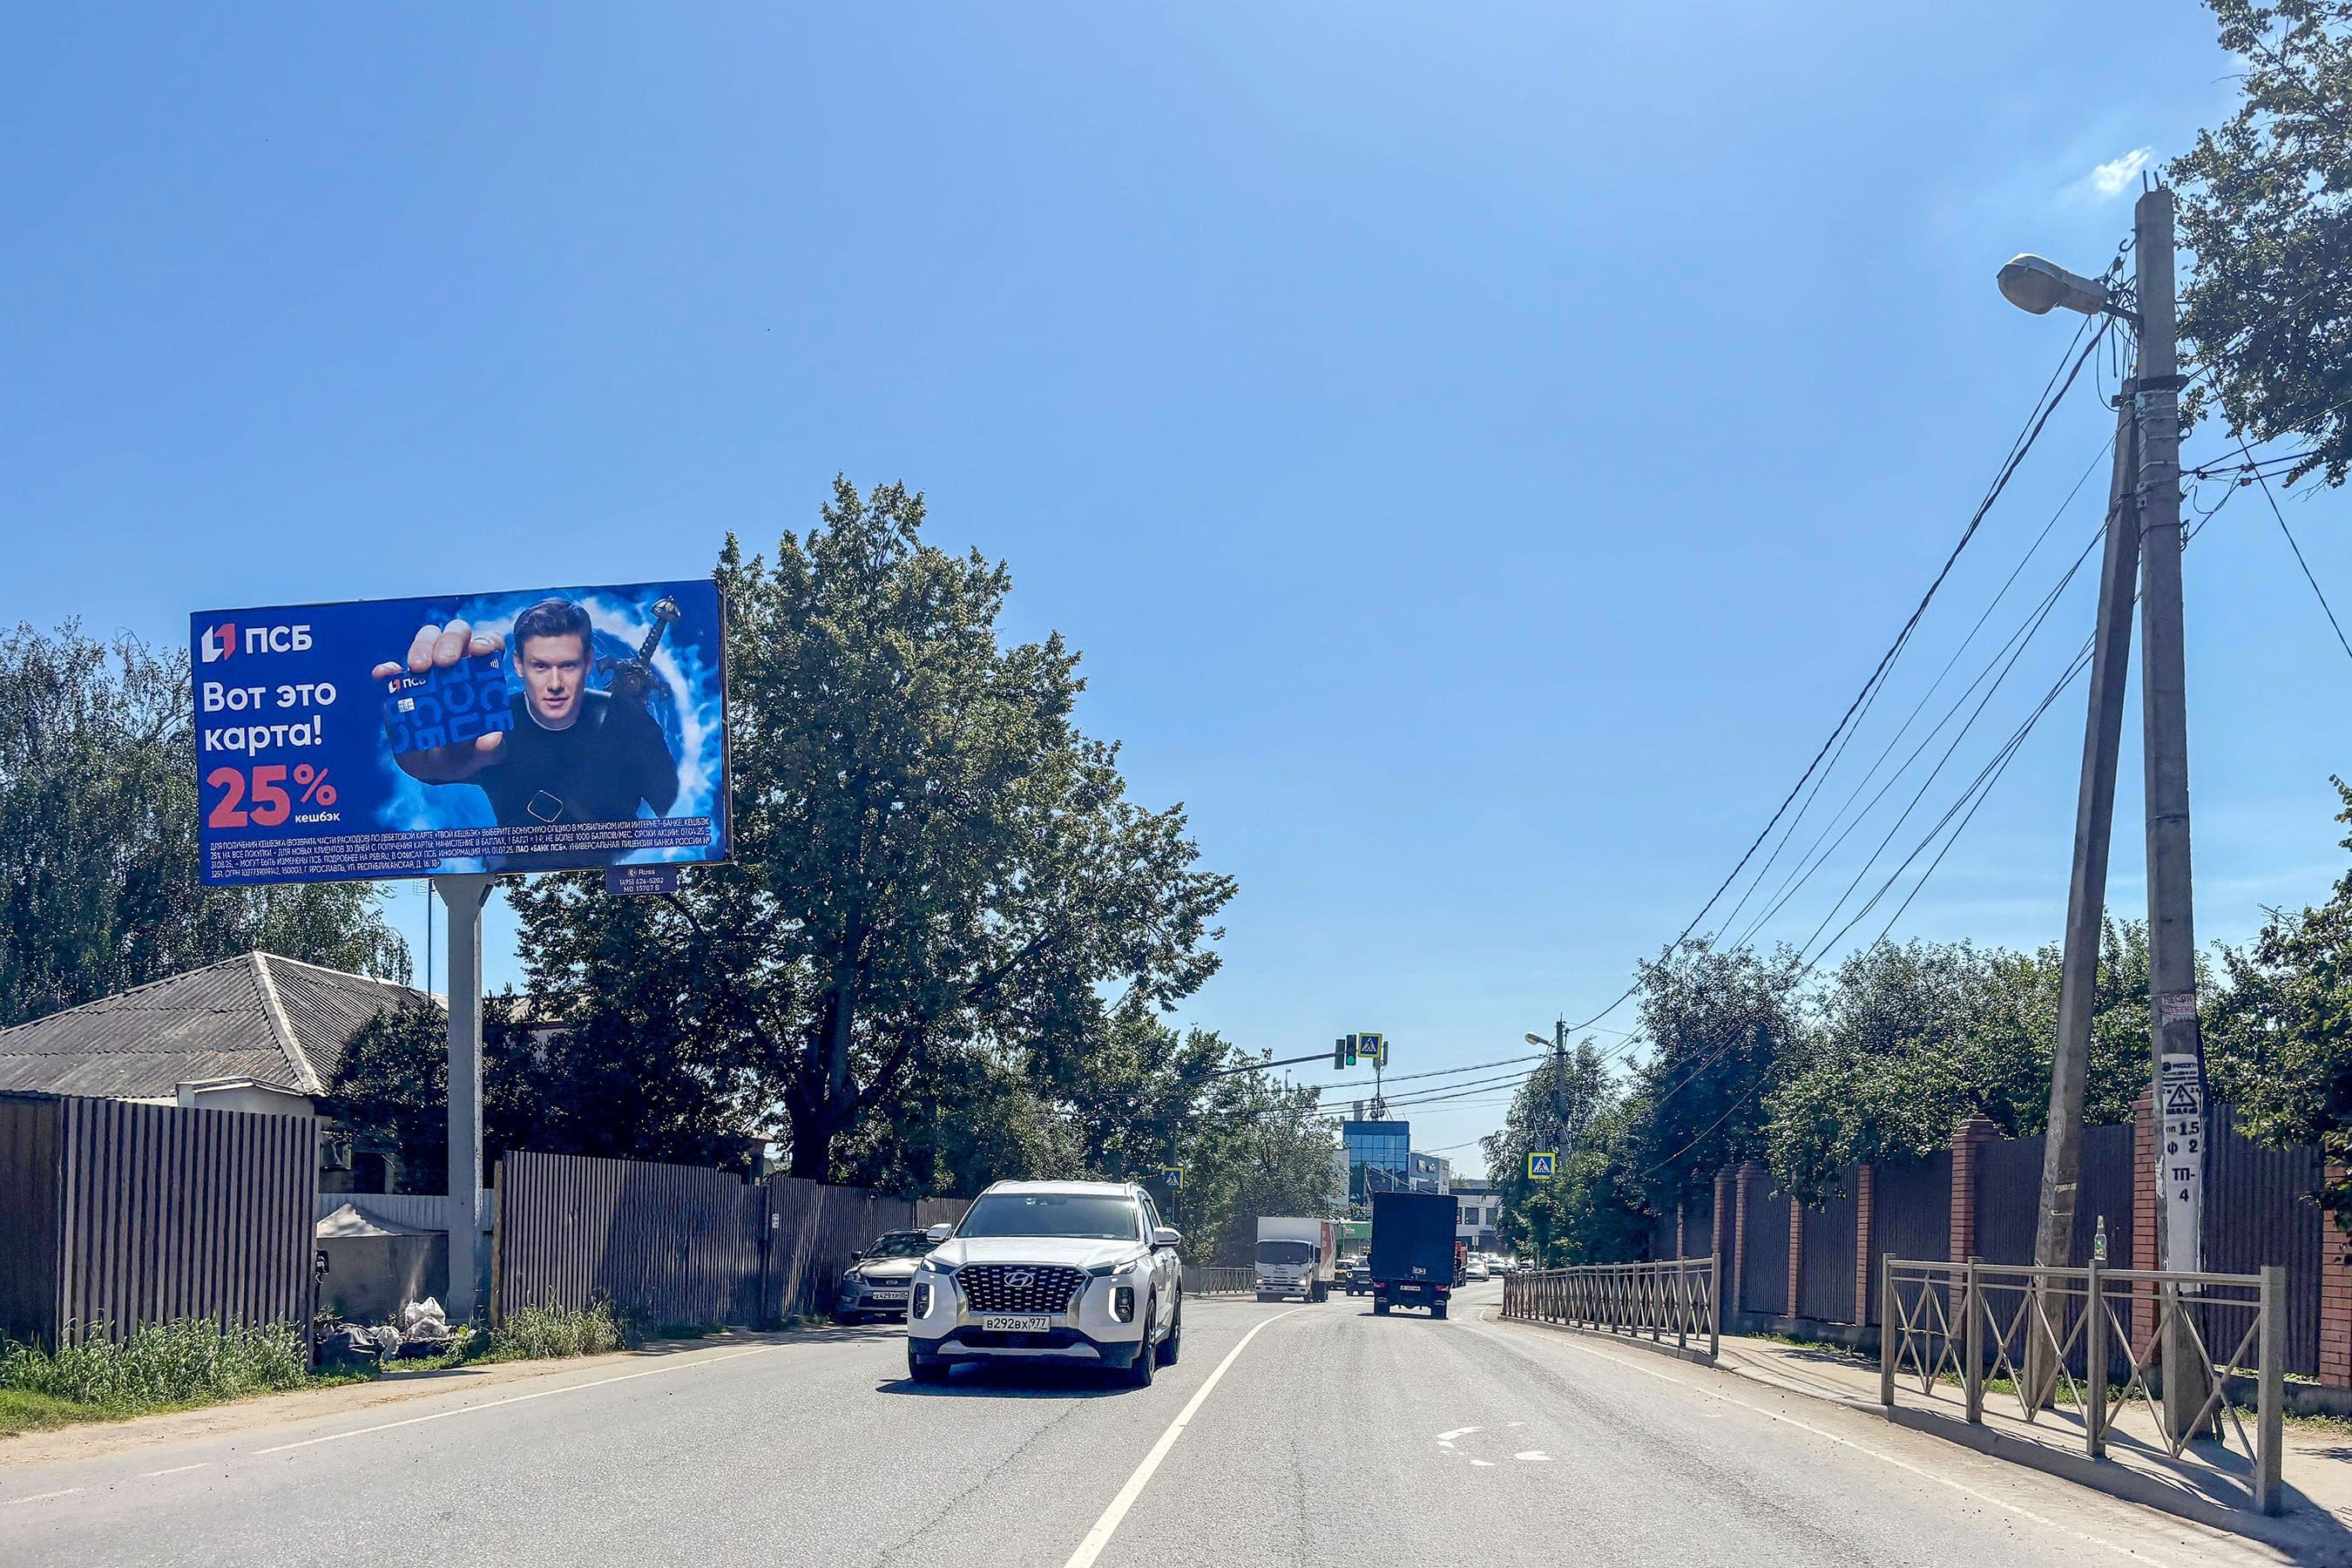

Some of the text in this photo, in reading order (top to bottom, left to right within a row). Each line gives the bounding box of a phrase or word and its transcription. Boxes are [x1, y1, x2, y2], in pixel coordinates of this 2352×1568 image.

[246, 625, 313, 654] ПСБ
[203, 681, 337, 713] Вот это
[205, 714, 322, 757] карта!
[206, 763, 337, 828] 25%
[294, 811, 341, 823] кешбэк
[371, 834, 380, 843] ПО
[381, 832, 415, 842] ДЕБЕТОВОЙ
[415, 831, 433, 841] КАРТЕ
[481, 827, 511, 837] ВЫБЕРИТЕ
[547, 825, 571, 834] ОПЦИЮ
[571, 824, 577, 833] В
[577, 822, 617, 833] МОБИЛЬНОМ
[684, 818, 710, 827] КЕШБЭК
[222, 851, 231, 859] НА
[232, 850, 243, 859] ВСЕ
[244, 849, 272, 858] ПОКУПКИ
[278, 848, 291, 857] ДЛЯ
[291, 847, 312, 856] НОВЫХ
[371, 844, 377, 852] С
[378, 842, 412, 852] ПОЛУЧЕНИЯ
[435, 839, 474, 849] НАЧИСЛЕНИЕ
[475, 838, 480, 847] В
[512, 836, 528, 845] БАЛЛ
[545, 835, 554, 843] НЕ
[554, 834, 574, 843] БОЛЕЕ
[634, 830, 656, 839] СРОКИ
[359, 853, 368, 862] НА
[392, 852, 396, 860] В
[438, 848, 481, 858] ИНФОРМАЦИЯ
[482, 848, 490, 856] НА
[515, 846, 529, 854] ПАО
[654, 839, 674, 847] БАНКА
[675, 837, 702, 846] РОССИИ
[2189, 1139, 2198, 1153] 2
[2180, 1187, 2189, 1202] 4
